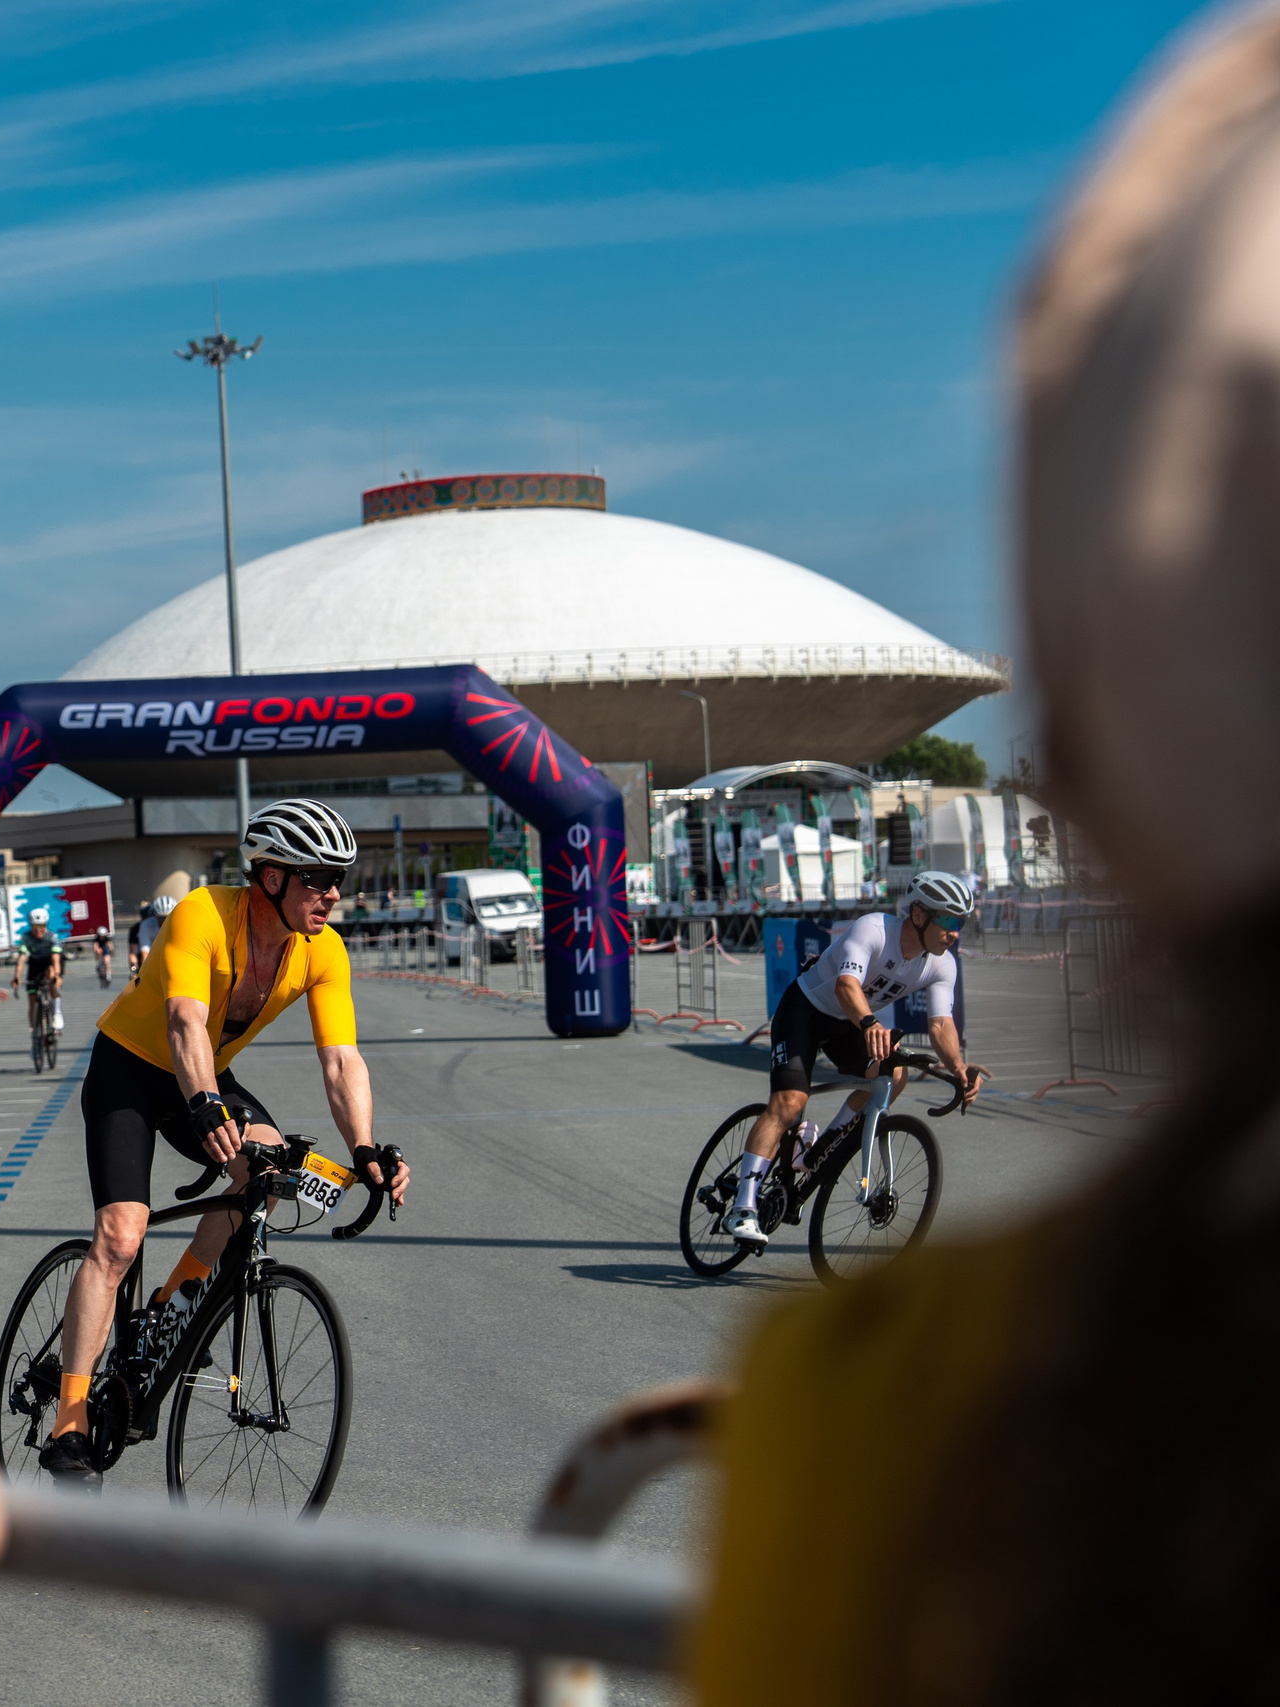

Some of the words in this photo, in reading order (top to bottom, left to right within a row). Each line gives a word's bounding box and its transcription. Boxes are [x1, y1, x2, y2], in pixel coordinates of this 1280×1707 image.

[165, 724, 366, 757] RUSSIA
[271, 842, 305, 862] S-WORKS
[567, 822, 601, 1016] ФИНИШ
[797, 1113, 862, 1190] PINARELLO
[298, 1172, 341, 1208] 4058
[330, 1170, 339, 1178] 50
[135, 1318, 147, 1360] LEZNE
